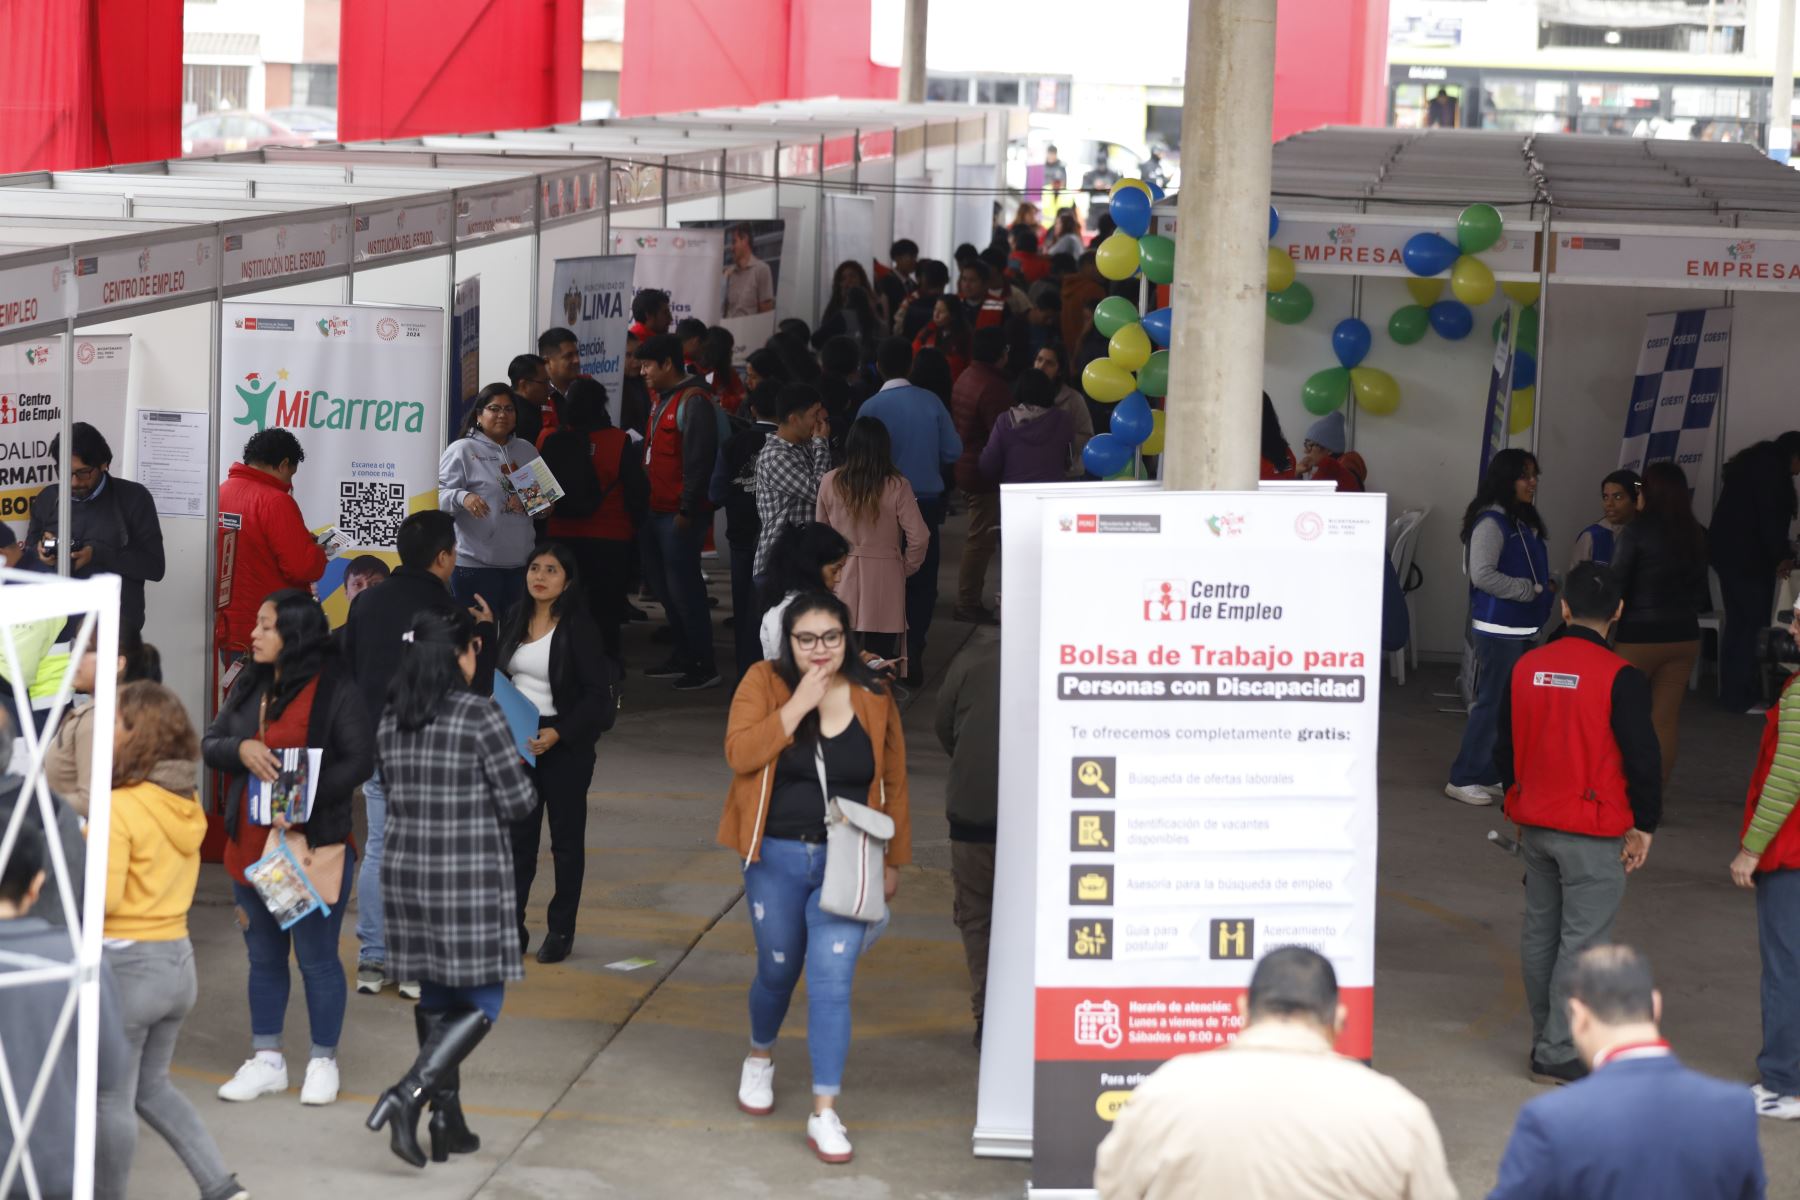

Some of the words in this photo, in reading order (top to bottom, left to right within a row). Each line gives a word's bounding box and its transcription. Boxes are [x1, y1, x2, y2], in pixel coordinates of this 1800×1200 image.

[402, 236, 412, 249] DEL
[413, 231, 434, 247] ESTADO
[1288, 244, 1403, 264] EMPRESA
[242, 252, 283, 279] INSTITUCIÓN
[284, 255, 299, 272] DEL
[299, 250, 326, 270] ESTADO
[1686, 260, 1800, 280] EMPRESA
[103, 277, 138, 304] CENTRO
[138, 276, 151, 296] DE
[152, 270, 185, 295] EMPLEO
[583, 292, 623, 321] LIMA
[18, 393, 52, 406] Centro
[18, 408, 31, 422] de
[275, 390, 425, 433] MiCarrera
[386, 462, 395, 470] QR
[1190, 580, 1250, 599] Centro
[1190, 601, 1212, 620] de
[1217, 602, 1283, 622] Empleo
[1060, 644, 1138, 666] Bolsa
[1148, 644, 1181, 666] de
[1190, 644, 1293, 670] Trabajo
[1304, 650, 1366, 670] para
[1063, 677, 1166, 696] Personas
[1170, 680, 1210, 696] con
[1216, 677, 1360, 698] Discapacidad
[1071, 726, 1087, 739] Te
[1093, 726, 1171, 740] ofrecemos
[1176, 727, 1292, 742] completamente
[1297, 728, 1351, 742] gratis:
[1186, 772, 1201, 784] de
[1204, 772, 1242, 784] ofertas
[1246, 772, 1294, 784] laborales
[1128, 817, 1200, 830] Identificación
[1204, 818, 1218, 830] de
[1222, 819, 1270, 830] vacantes
[1128, 834, 1190, 846] disponibles
[1176, 880, 1200, 891] para
[1204, 878, 1214, 889] la
[1275, 878, 1288, 890] de
[1292, 878, 1333, 891] empleo
[1154, 926, 1178, 938] para
[1263, 924, 1336, 936] Acercamiento
[1126, 940, 1168, 952] postular
[1129, 1001, 1166, 1012] Horario
[1168, 1002, 1182, 1012] de
[1184, 1000, 1232, 1012] atención:
[1128, 1016, 1157, 1028] Lunes
[1160, 1018, 1167, 1027] a
[1169, 1016, 1204, 1028] viernes
[1206, 1016, 1219, 1028] de
[1128, 1031, 1171, 1043] Sábados
[1173, 1032, 1186, 1043] de
[1188, 1031, 1212, 1043] 9:00
[1100, 1072, 1125, 1086] Para
